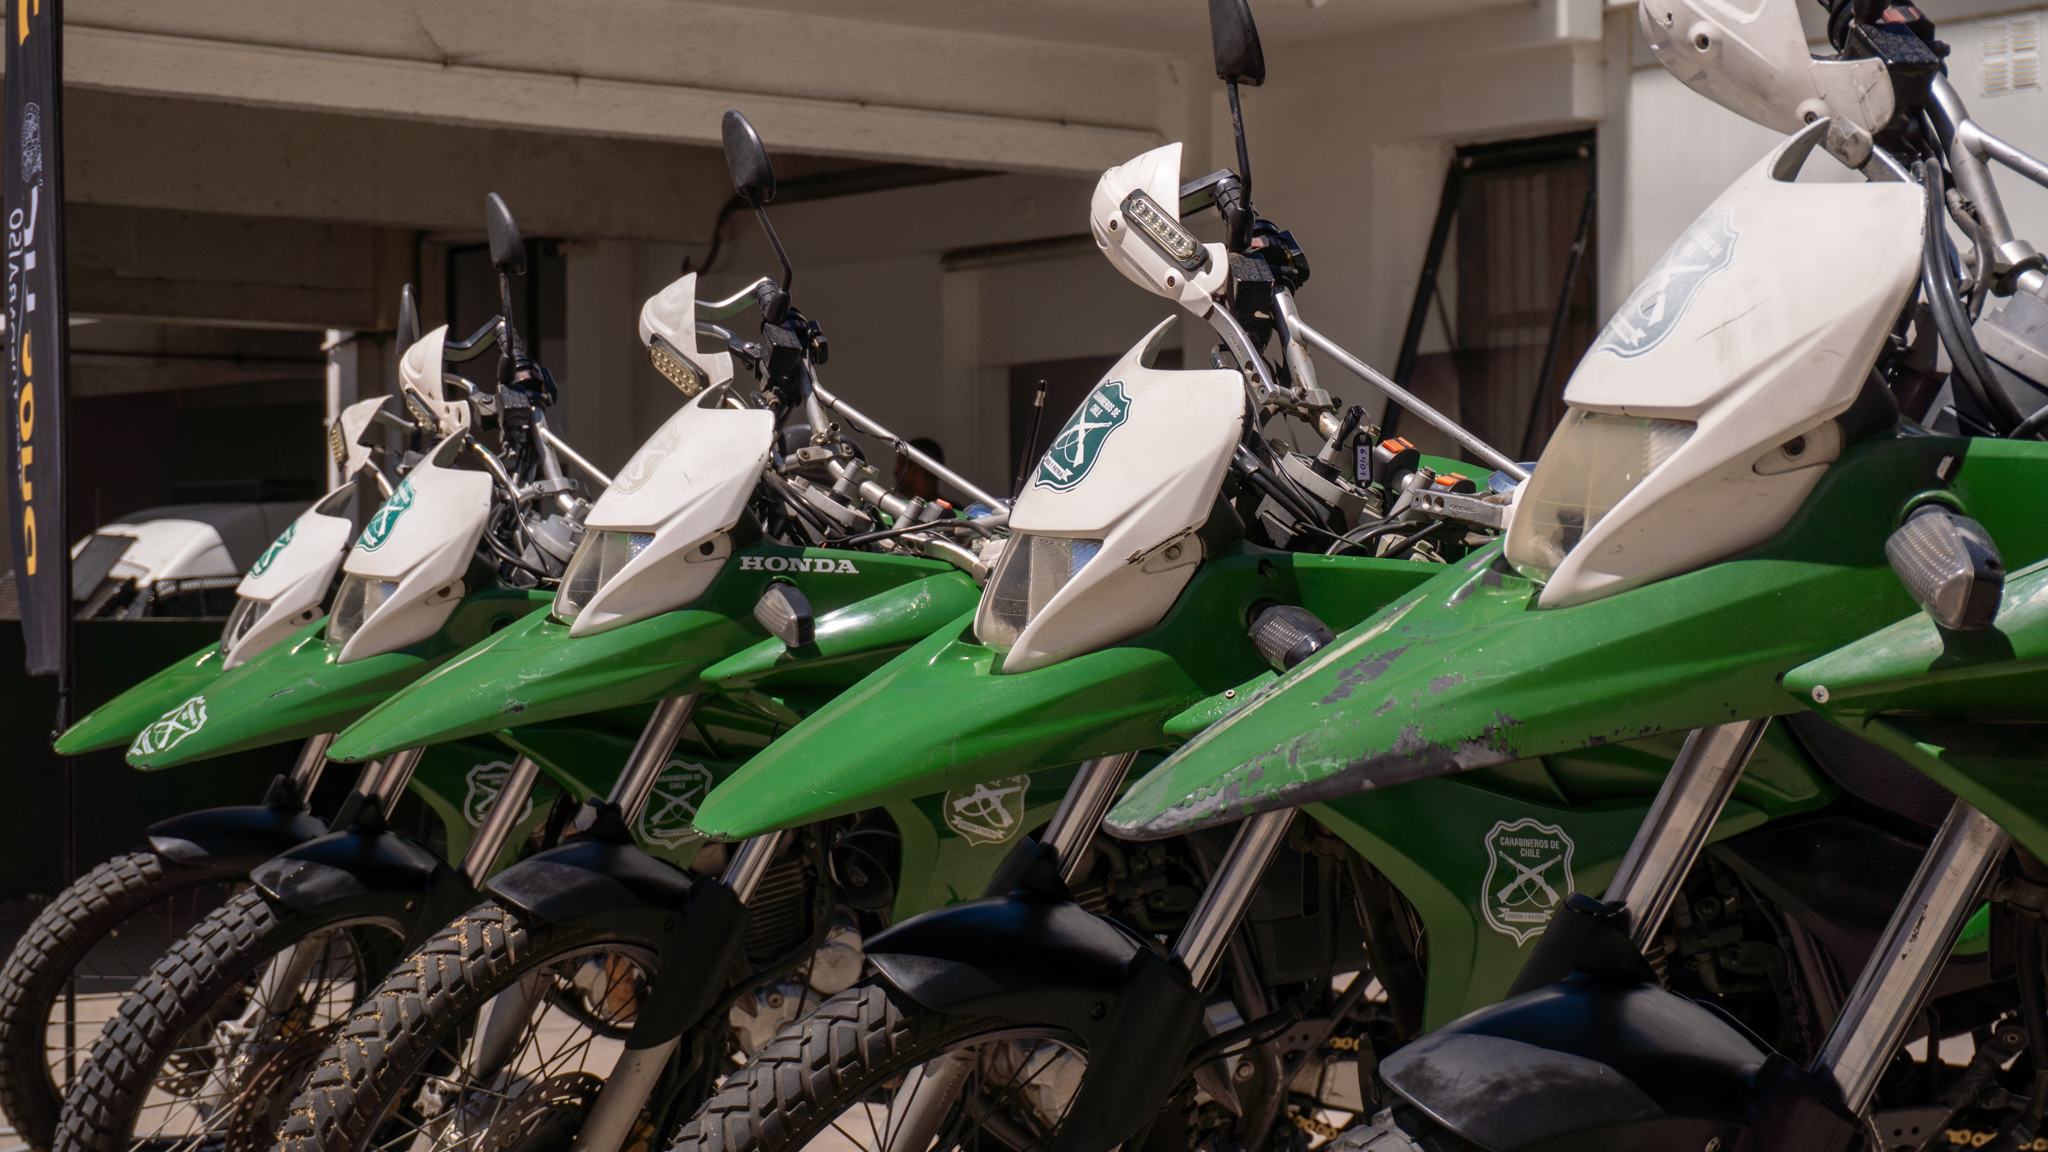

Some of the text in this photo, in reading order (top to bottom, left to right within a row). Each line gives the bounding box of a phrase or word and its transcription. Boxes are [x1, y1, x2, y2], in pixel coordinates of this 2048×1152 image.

[739, 556, 859, 574] HONDA
[669, 782, 686, 790] CHILE
[1500, 836, 1560, 850] CARABINEROS DE
[1520, 847, 1541, 858] CHILE
